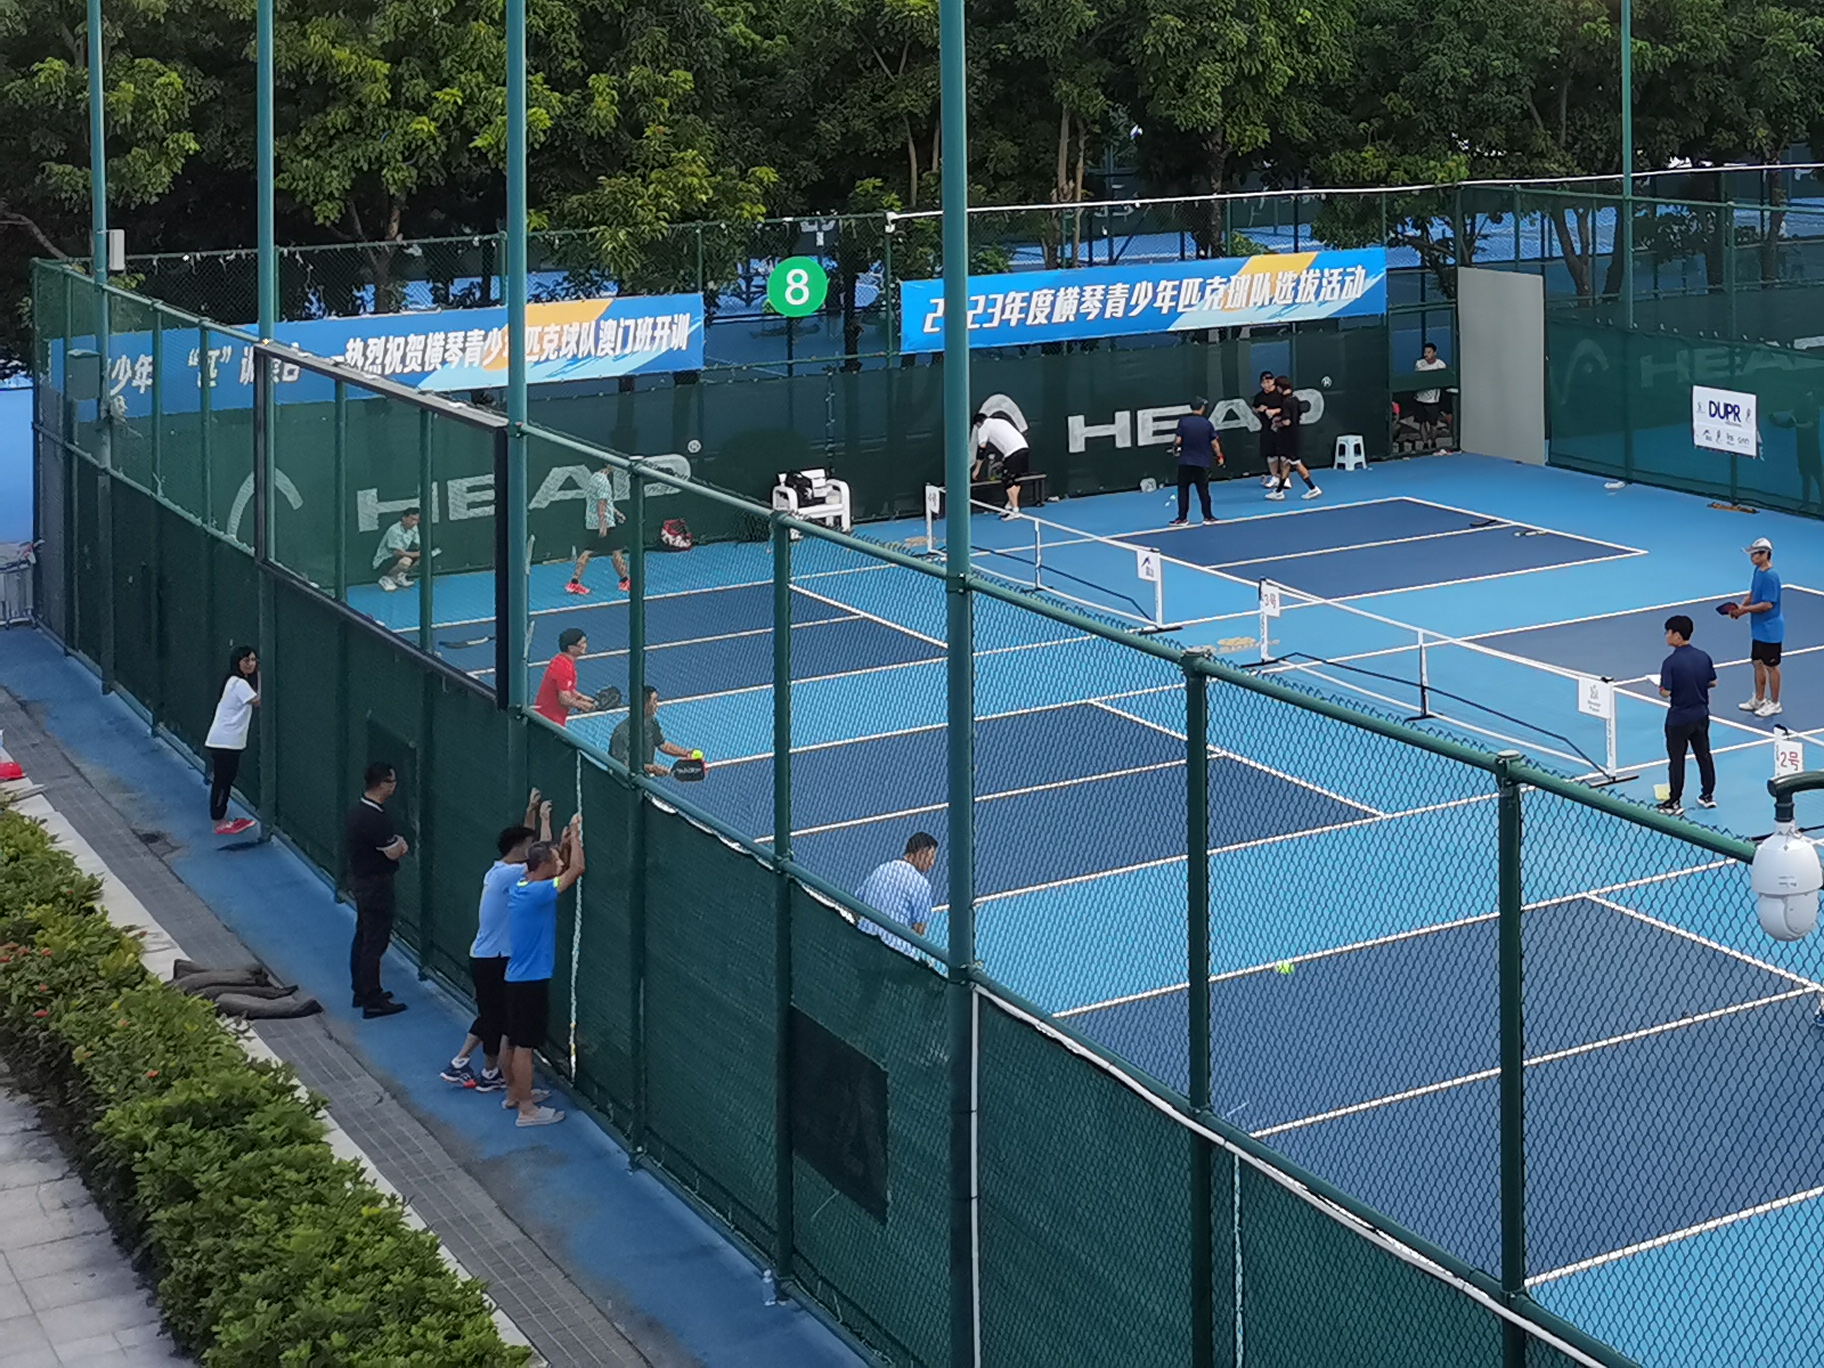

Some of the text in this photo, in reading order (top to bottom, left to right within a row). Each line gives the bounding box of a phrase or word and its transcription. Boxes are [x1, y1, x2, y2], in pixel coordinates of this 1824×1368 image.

[784, 268, 810, 306] 8
[923, 264, 1367, 333] 223年度横琴青少年匹克球队选拔活动
[345, 313, 690, 376] 热烈祝贺横琴青少匹克球队澳门班开训
[1709, 400, 1741, 423] DUPR
[1780, 751, 1800, 772] 2号
